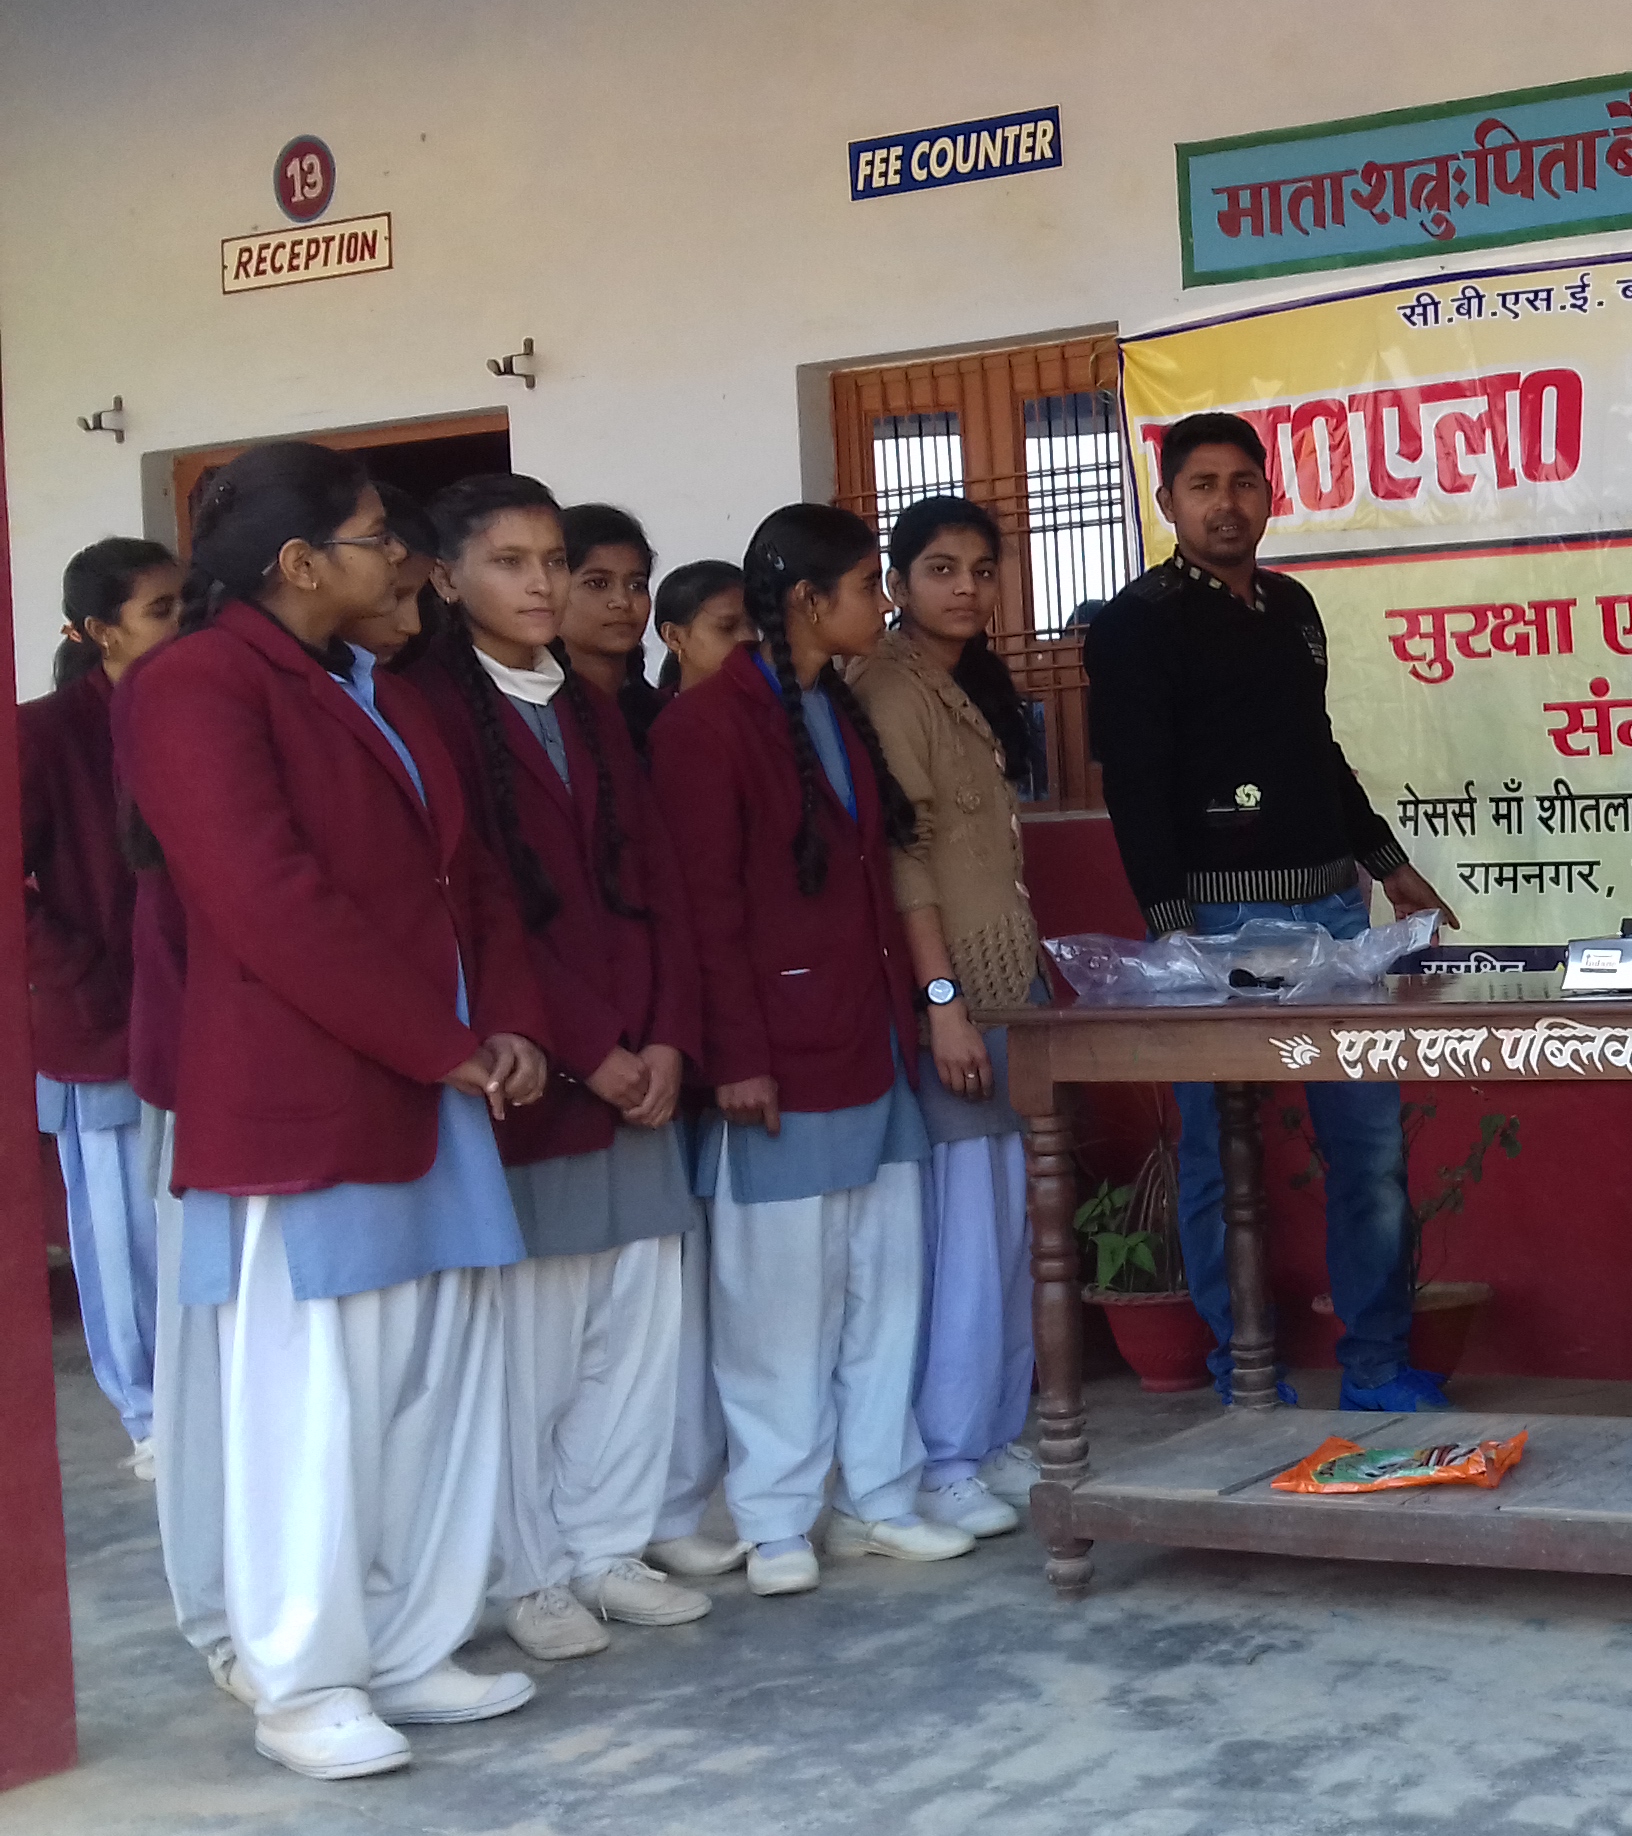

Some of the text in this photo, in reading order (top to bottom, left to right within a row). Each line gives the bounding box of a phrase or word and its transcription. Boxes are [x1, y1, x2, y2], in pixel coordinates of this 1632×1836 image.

[285, 152, 324, 203] 13
[856, 119, 1054, 191] FEE COUNTER
[233, 229, 378, 280] RECEPTION
[1385, 597, 1578, 685] सुरक्षा
[1398, 779, 1478, 838] मेसर्स
